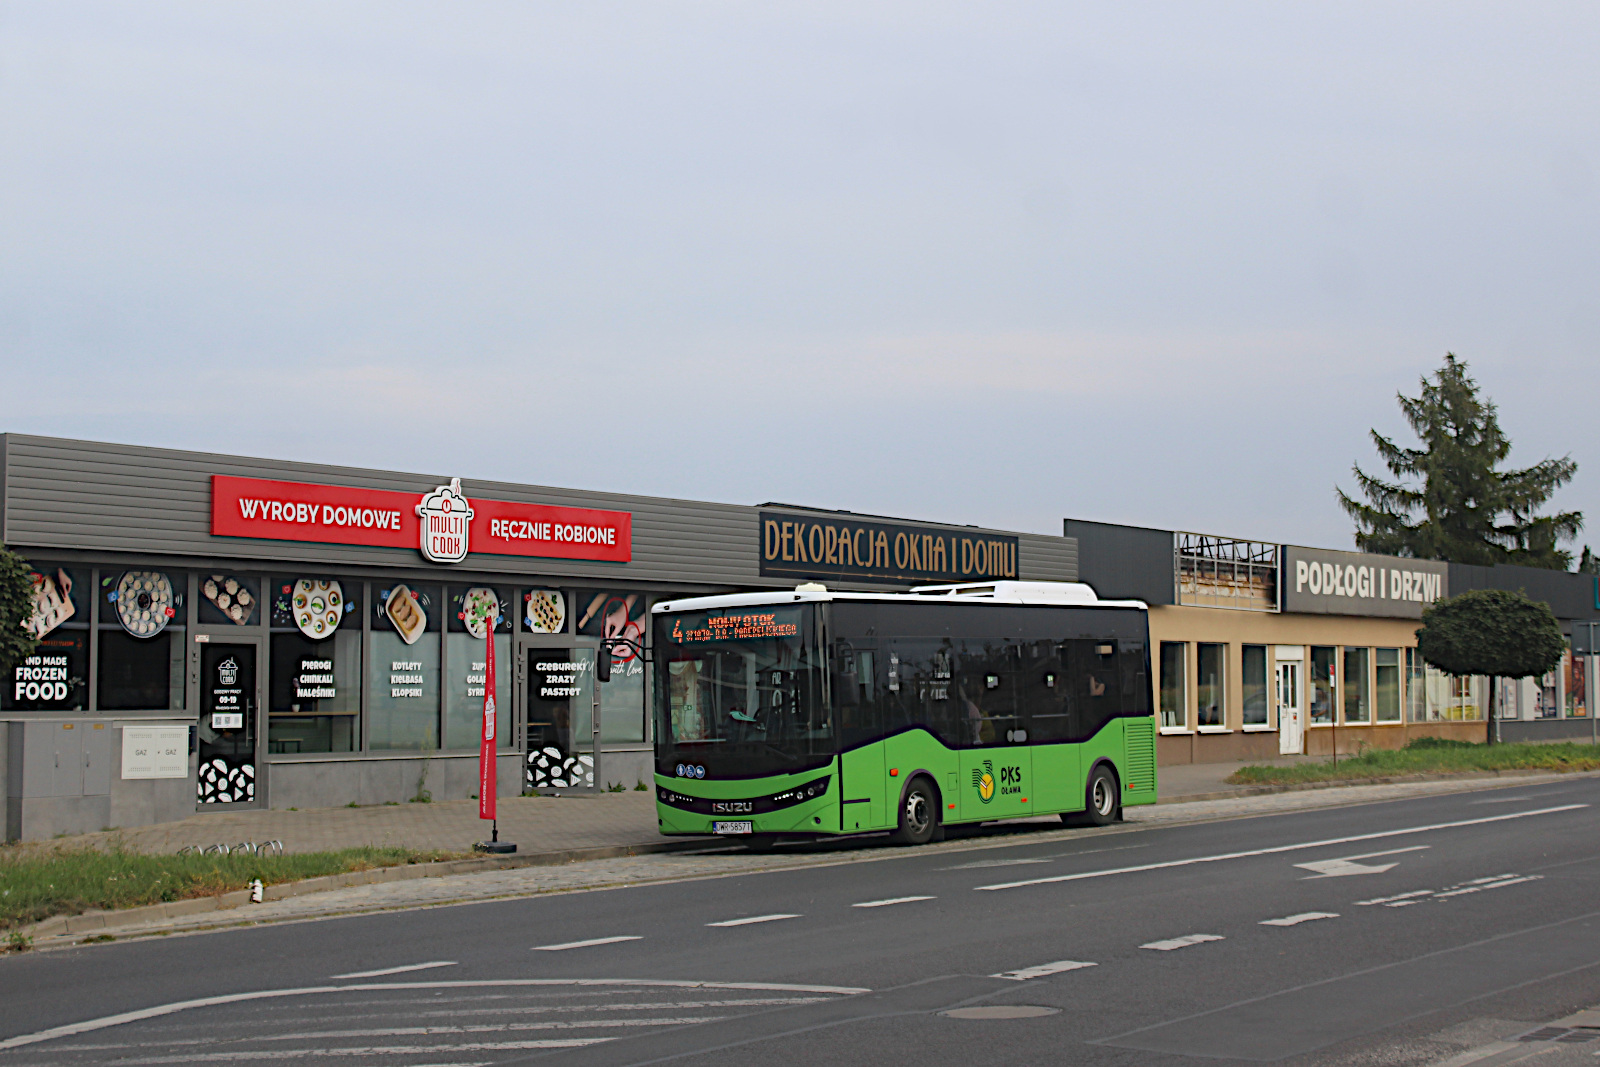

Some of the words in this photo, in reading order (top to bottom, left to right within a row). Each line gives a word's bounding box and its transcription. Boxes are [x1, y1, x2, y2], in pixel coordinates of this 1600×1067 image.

[238, 498, 320, 524] WYROBY
[323, 505, 401, 530] DOMOWE
[430, 515, 463, 535] MULTI
[491, 518, 552, 542] RĘCZNIE
[554, 524, 616, 545] ROBIONE
[432, 536, 460, 555] COOK
[764, 520, 889, 568] DEKORACJA
[894, 532, 947, 572] OKNA
[951, 537, 957, 573] I
[961, 538, 1016, 577] DOMU
[1296, 560, 1375, 598] PODŁOGI
[1380, 568, 1386, 599] I
[1391, 569, 1441, 603] DRZWI
[743, 613, 776, 627] OTOK
[672, 619, 683, 643] 4
[43, 656, 67, 666] MADE
[15, 667, 68, 681] FROZEN
[546, 675, 576, 684] ZRAZY
[15, 682, 68, 701] FOOD
[135, 749, 147, 757] GAZ
[165, 748, 177, 756] GAZ
[1001, 766, 1022, 786] PKS
[712, 802, 753, 813] ISUZU
